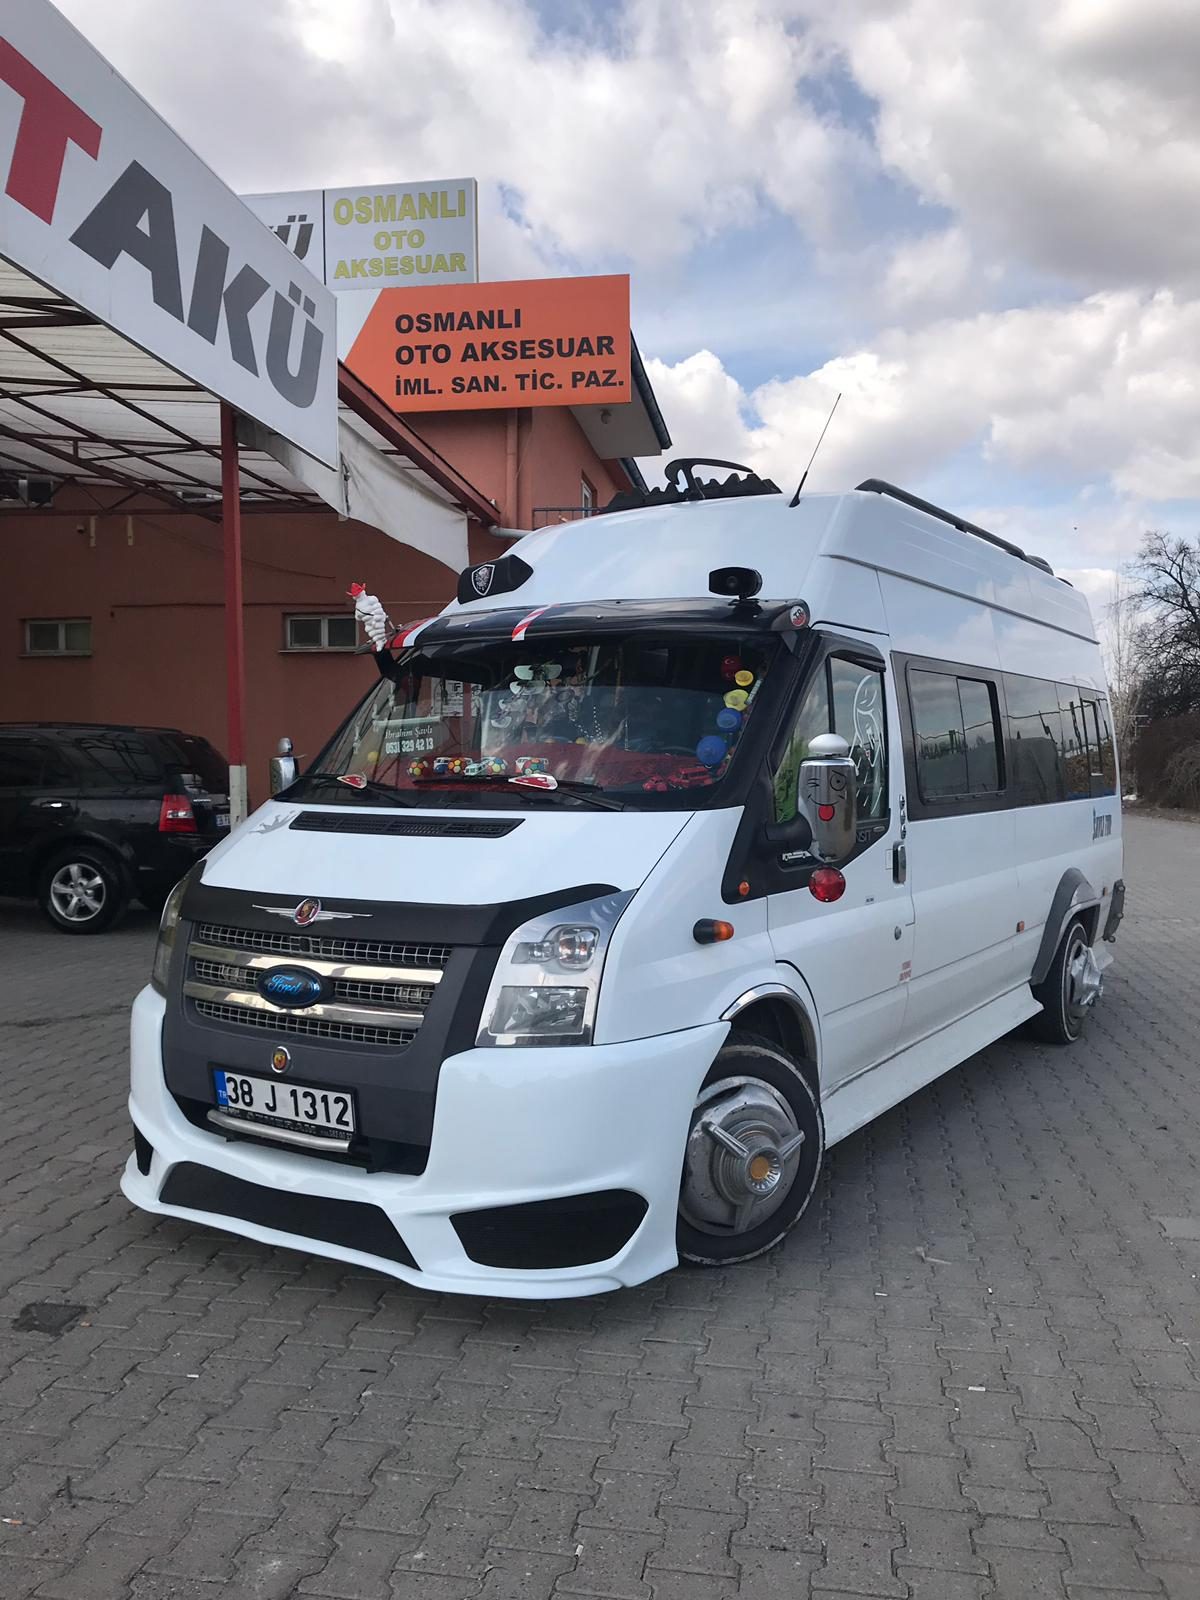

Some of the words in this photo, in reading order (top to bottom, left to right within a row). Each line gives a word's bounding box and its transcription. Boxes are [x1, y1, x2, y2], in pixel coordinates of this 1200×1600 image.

[333, 189, 467, 225] OSMANLI
[373, 229, 426, 250] OTO
[333, 252, 467, 279] AKSESUAR
[69, 159, 324, 409] AKÜ
[395, 308, 522, 334] OSMANLI
[395, 344, 451, 365] OTO
[460, 335, 615, 362] AKSESUAR
[395, 374, 443, 396] İML.
[451, 374, 507, 394] SAN.
[515, 368, 563, 391] TİC.
[571, 369, 624, 389] PAZ.
[415, 738, 425, 751] 42
[425, 737, 434, 750] 13
[267, 974, 302, 993] Ford
[226, 1076, 253, 1107] 38
[265, 1085, 277, 1112] J
[290, 1089, 350, 1127] 1312
